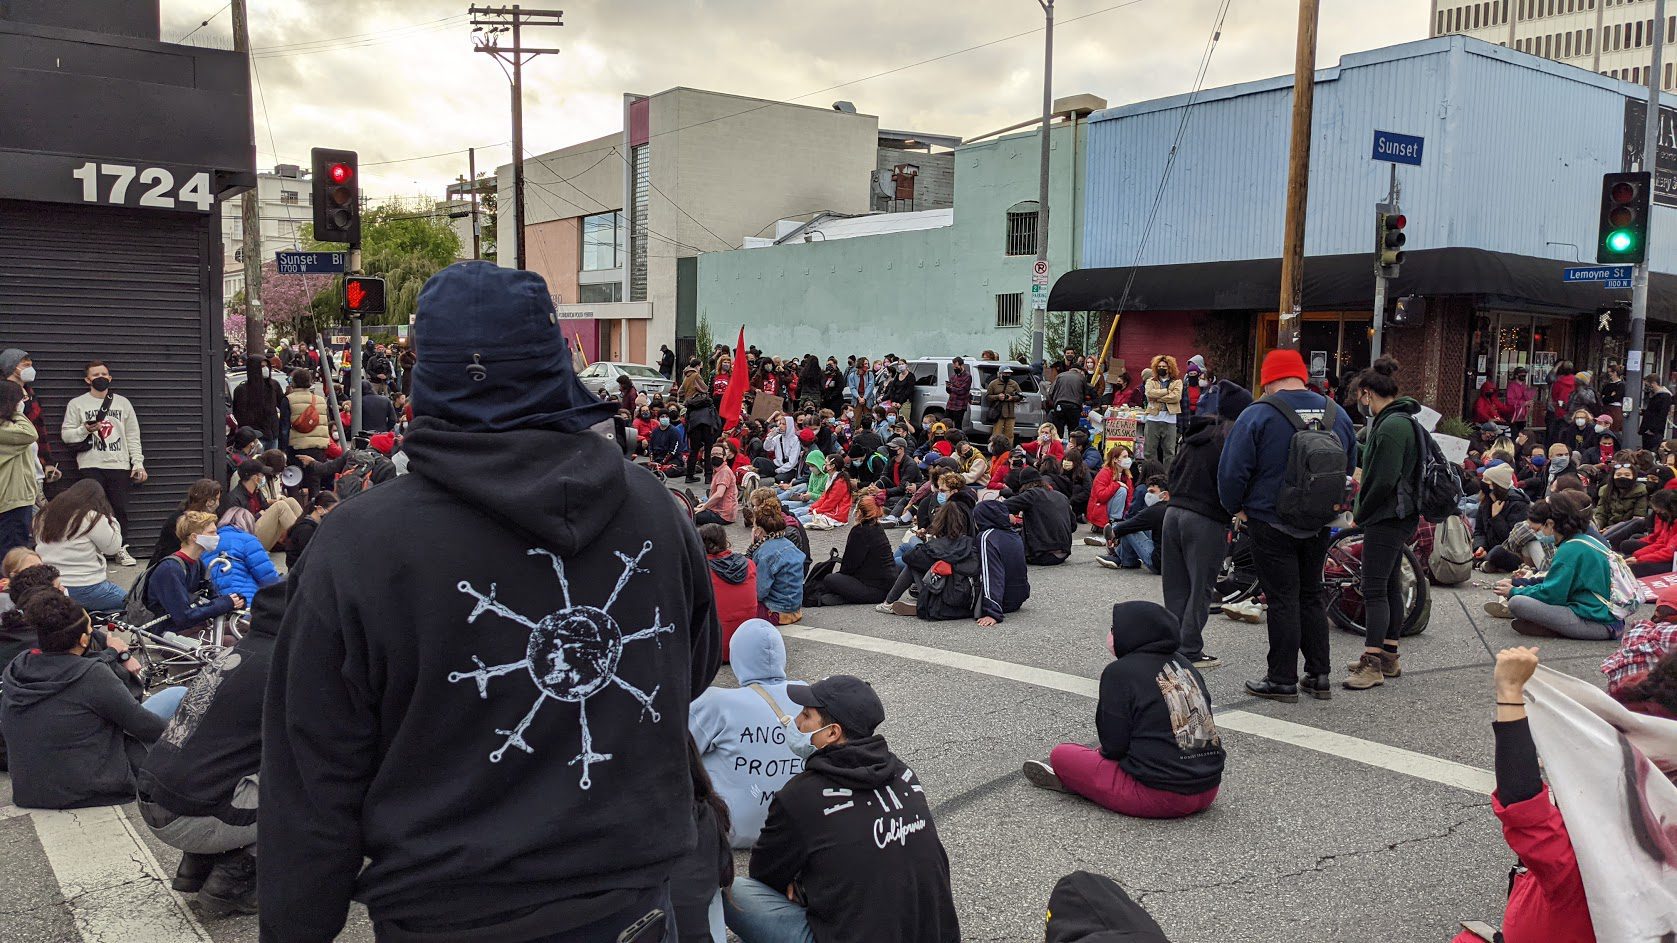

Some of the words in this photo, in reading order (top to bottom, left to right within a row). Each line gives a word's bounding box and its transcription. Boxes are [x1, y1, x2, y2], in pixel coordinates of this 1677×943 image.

[1378, 137, 1418, 157] Sunset
[73, 162, 214, 211] 1724
[280, 253, 318, 265] Sunset
[1570, 269, 1610, 280] Lemoyne
[1613, 268, 1624, 278] St
[740, 726, 786, 745] ANG
[873, 814, 926, 849] California
